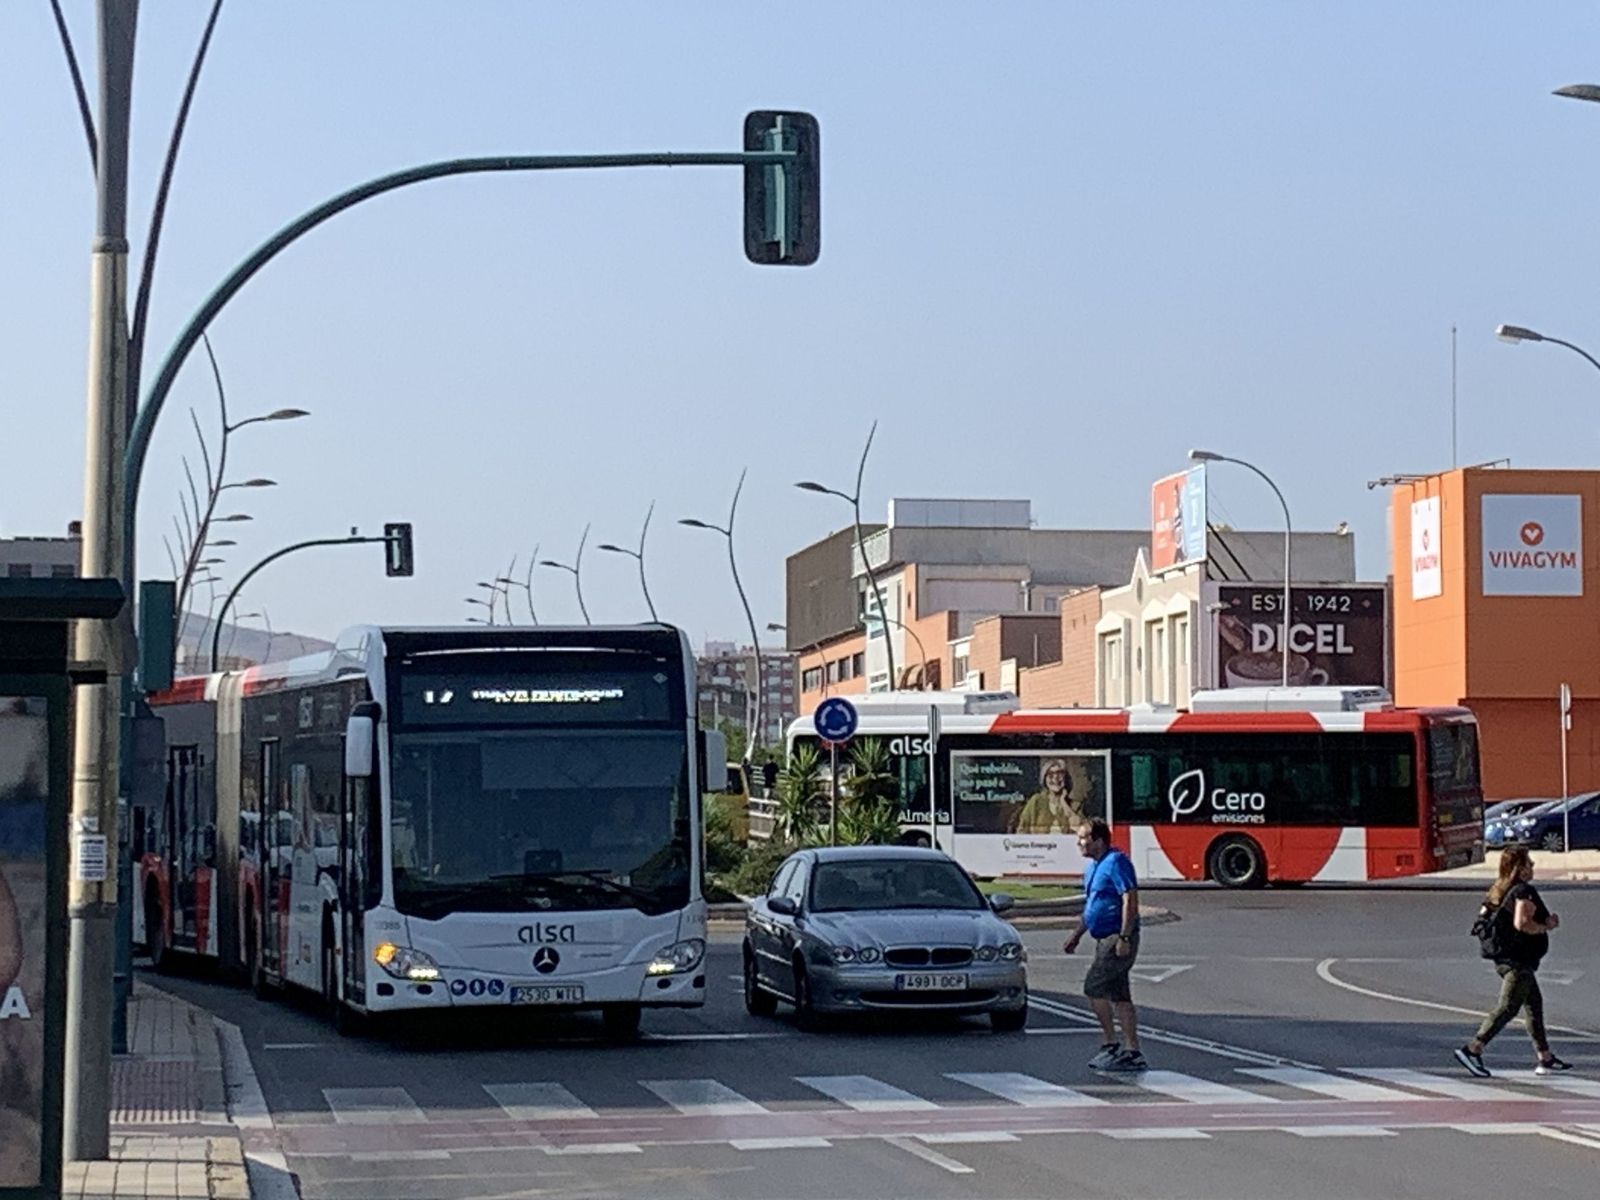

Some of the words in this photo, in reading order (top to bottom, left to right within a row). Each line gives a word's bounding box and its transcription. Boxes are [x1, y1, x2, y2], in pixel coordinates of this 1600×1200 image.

[1489, 551, 1576, 569] VIVAGYM
[1307, 595, 1351, 612] 1942
[1252, 623, 1354, 654] DICEL
[889, 735, 937, 756] alsa
[1211, 788, 1266, 811] Cero
[1211, 813, 1266, 824] emisiones
[518, 922, 575, 944] alsa
[518, 988, 550, 1001] 2530
